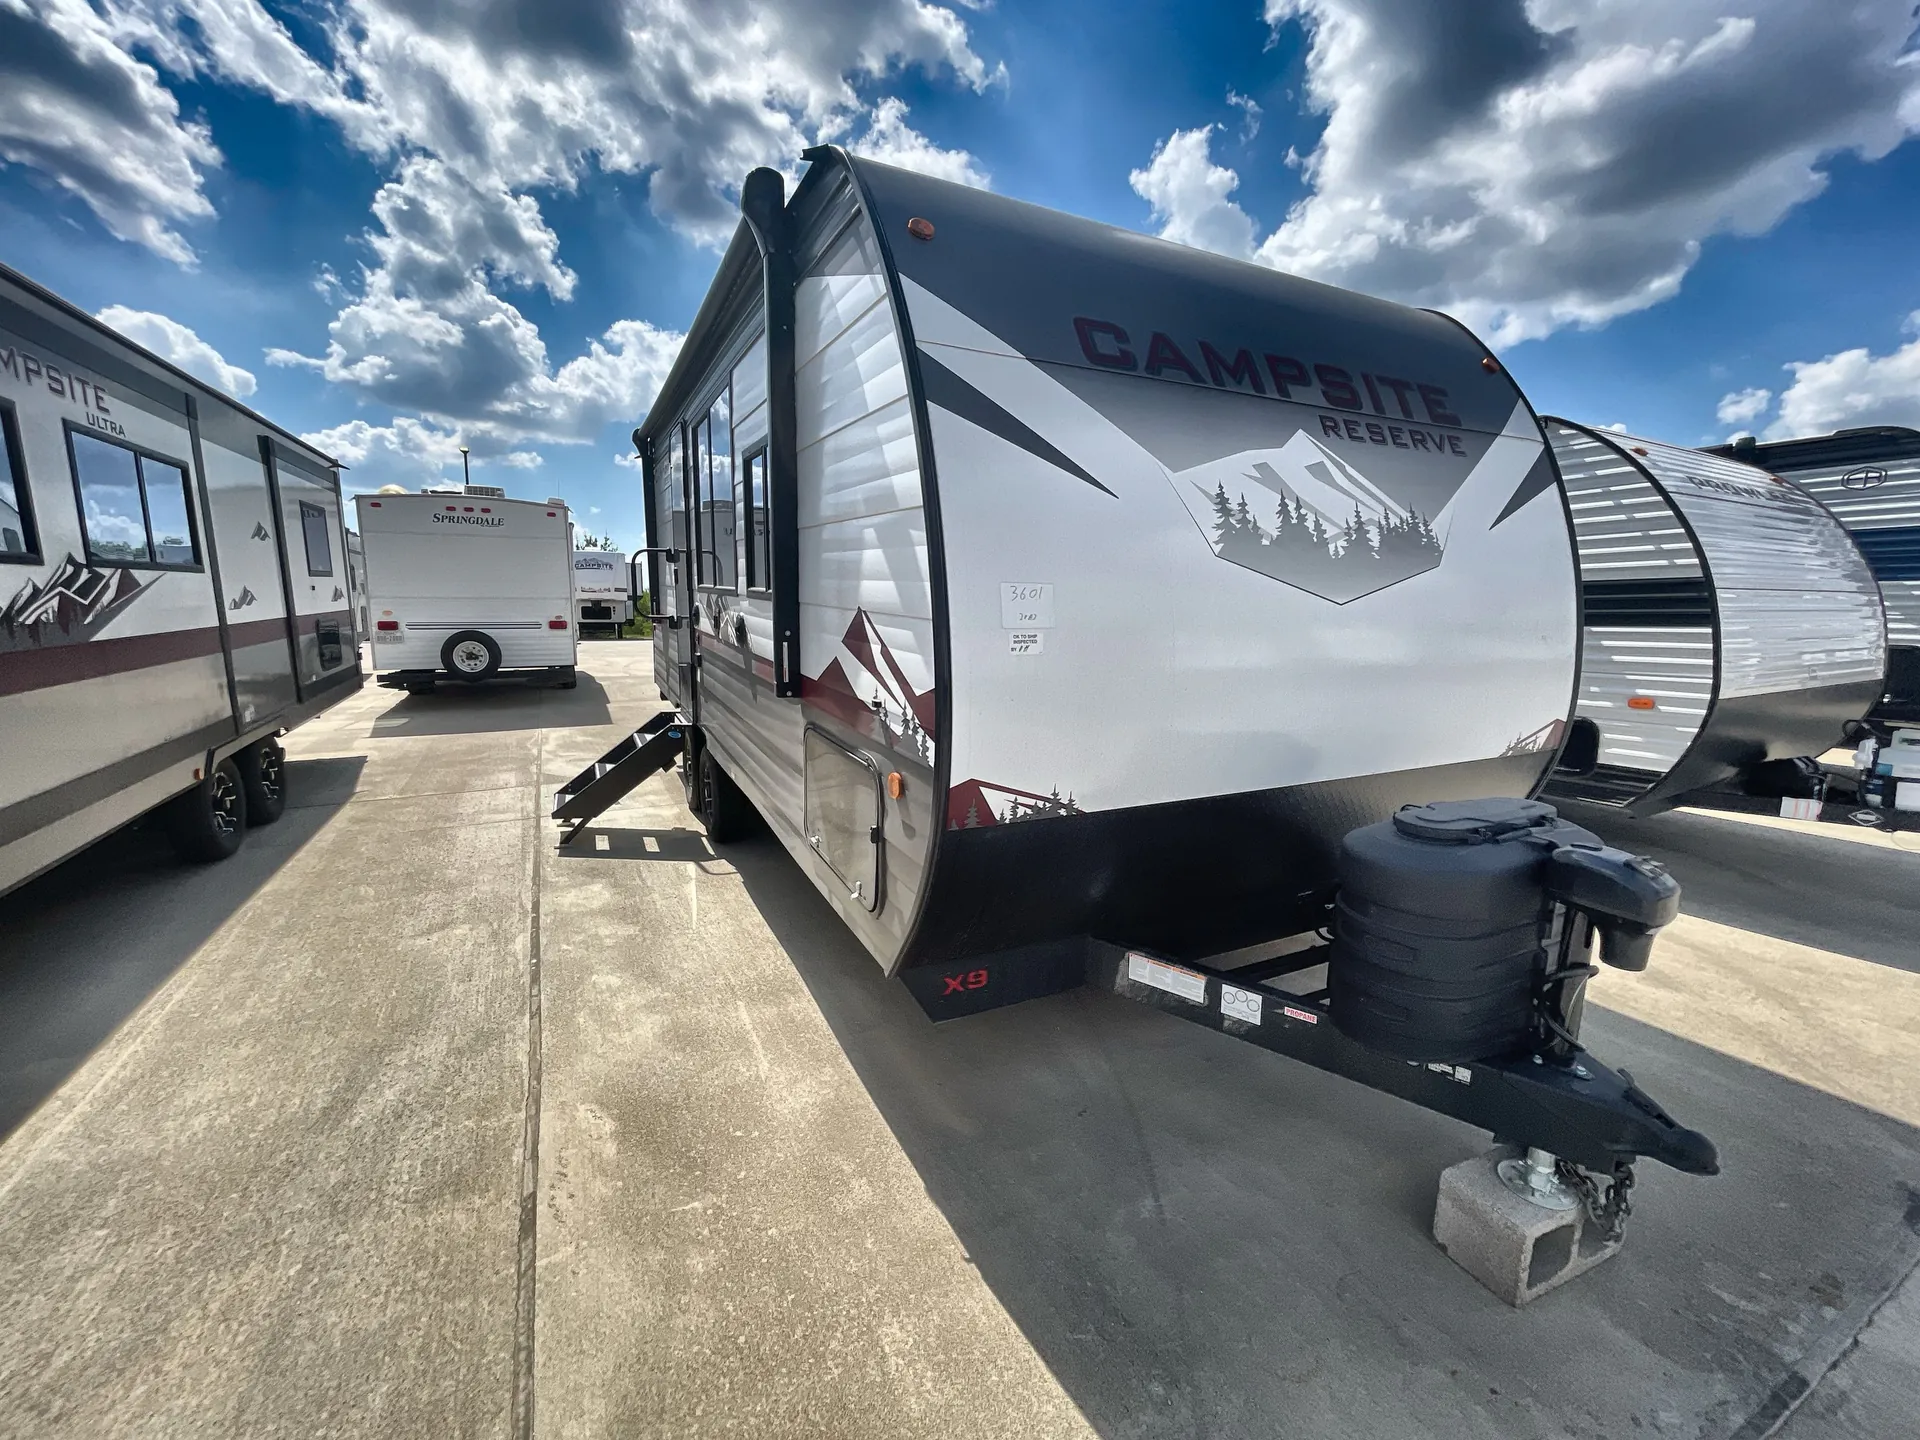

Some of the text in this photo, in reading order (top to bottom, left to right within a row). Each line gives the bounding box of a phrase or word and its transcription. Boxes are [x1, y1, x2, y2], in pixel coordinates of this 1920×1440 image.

[1072, 315, 1463, 428] CAMPSITE
[86, 411, 127, 438] ULTRA
[1318, 414, 1468, 458] RESERVE
[432, 513, 505, 526] SPRINGDALE
[1009, 585, 1043, 602] 3601
[942, 968, 988, 996] X9
[1286, 1008, 1316, 1022] PROPANE
